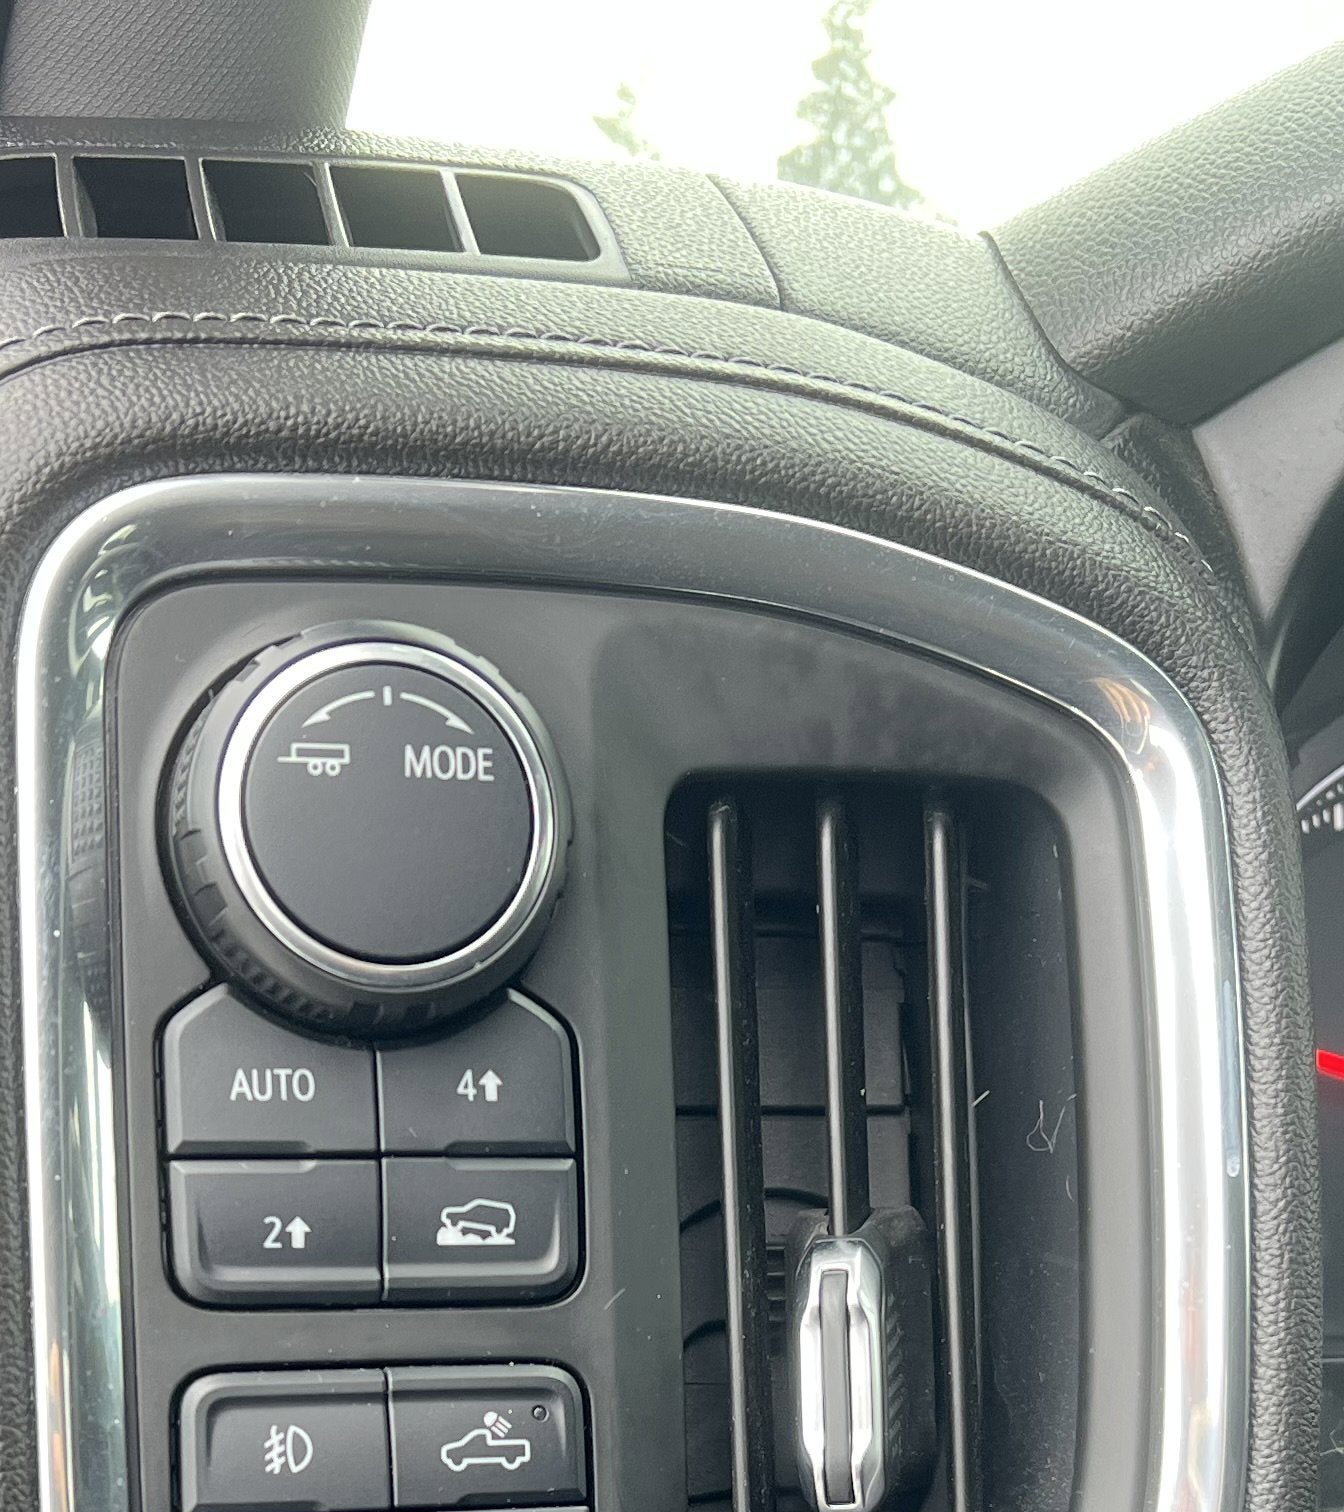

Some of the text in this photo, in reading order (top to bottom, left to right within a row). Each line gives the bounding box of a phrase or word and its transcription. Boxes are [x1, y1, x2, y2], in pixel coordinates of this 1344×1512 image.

[404, 744, 495, 782] MODE
[230, 1068, 316, 1102] AUTO
[456, 1069, 478, 1102] 4
[263, 1216, 283, 1249] 2
